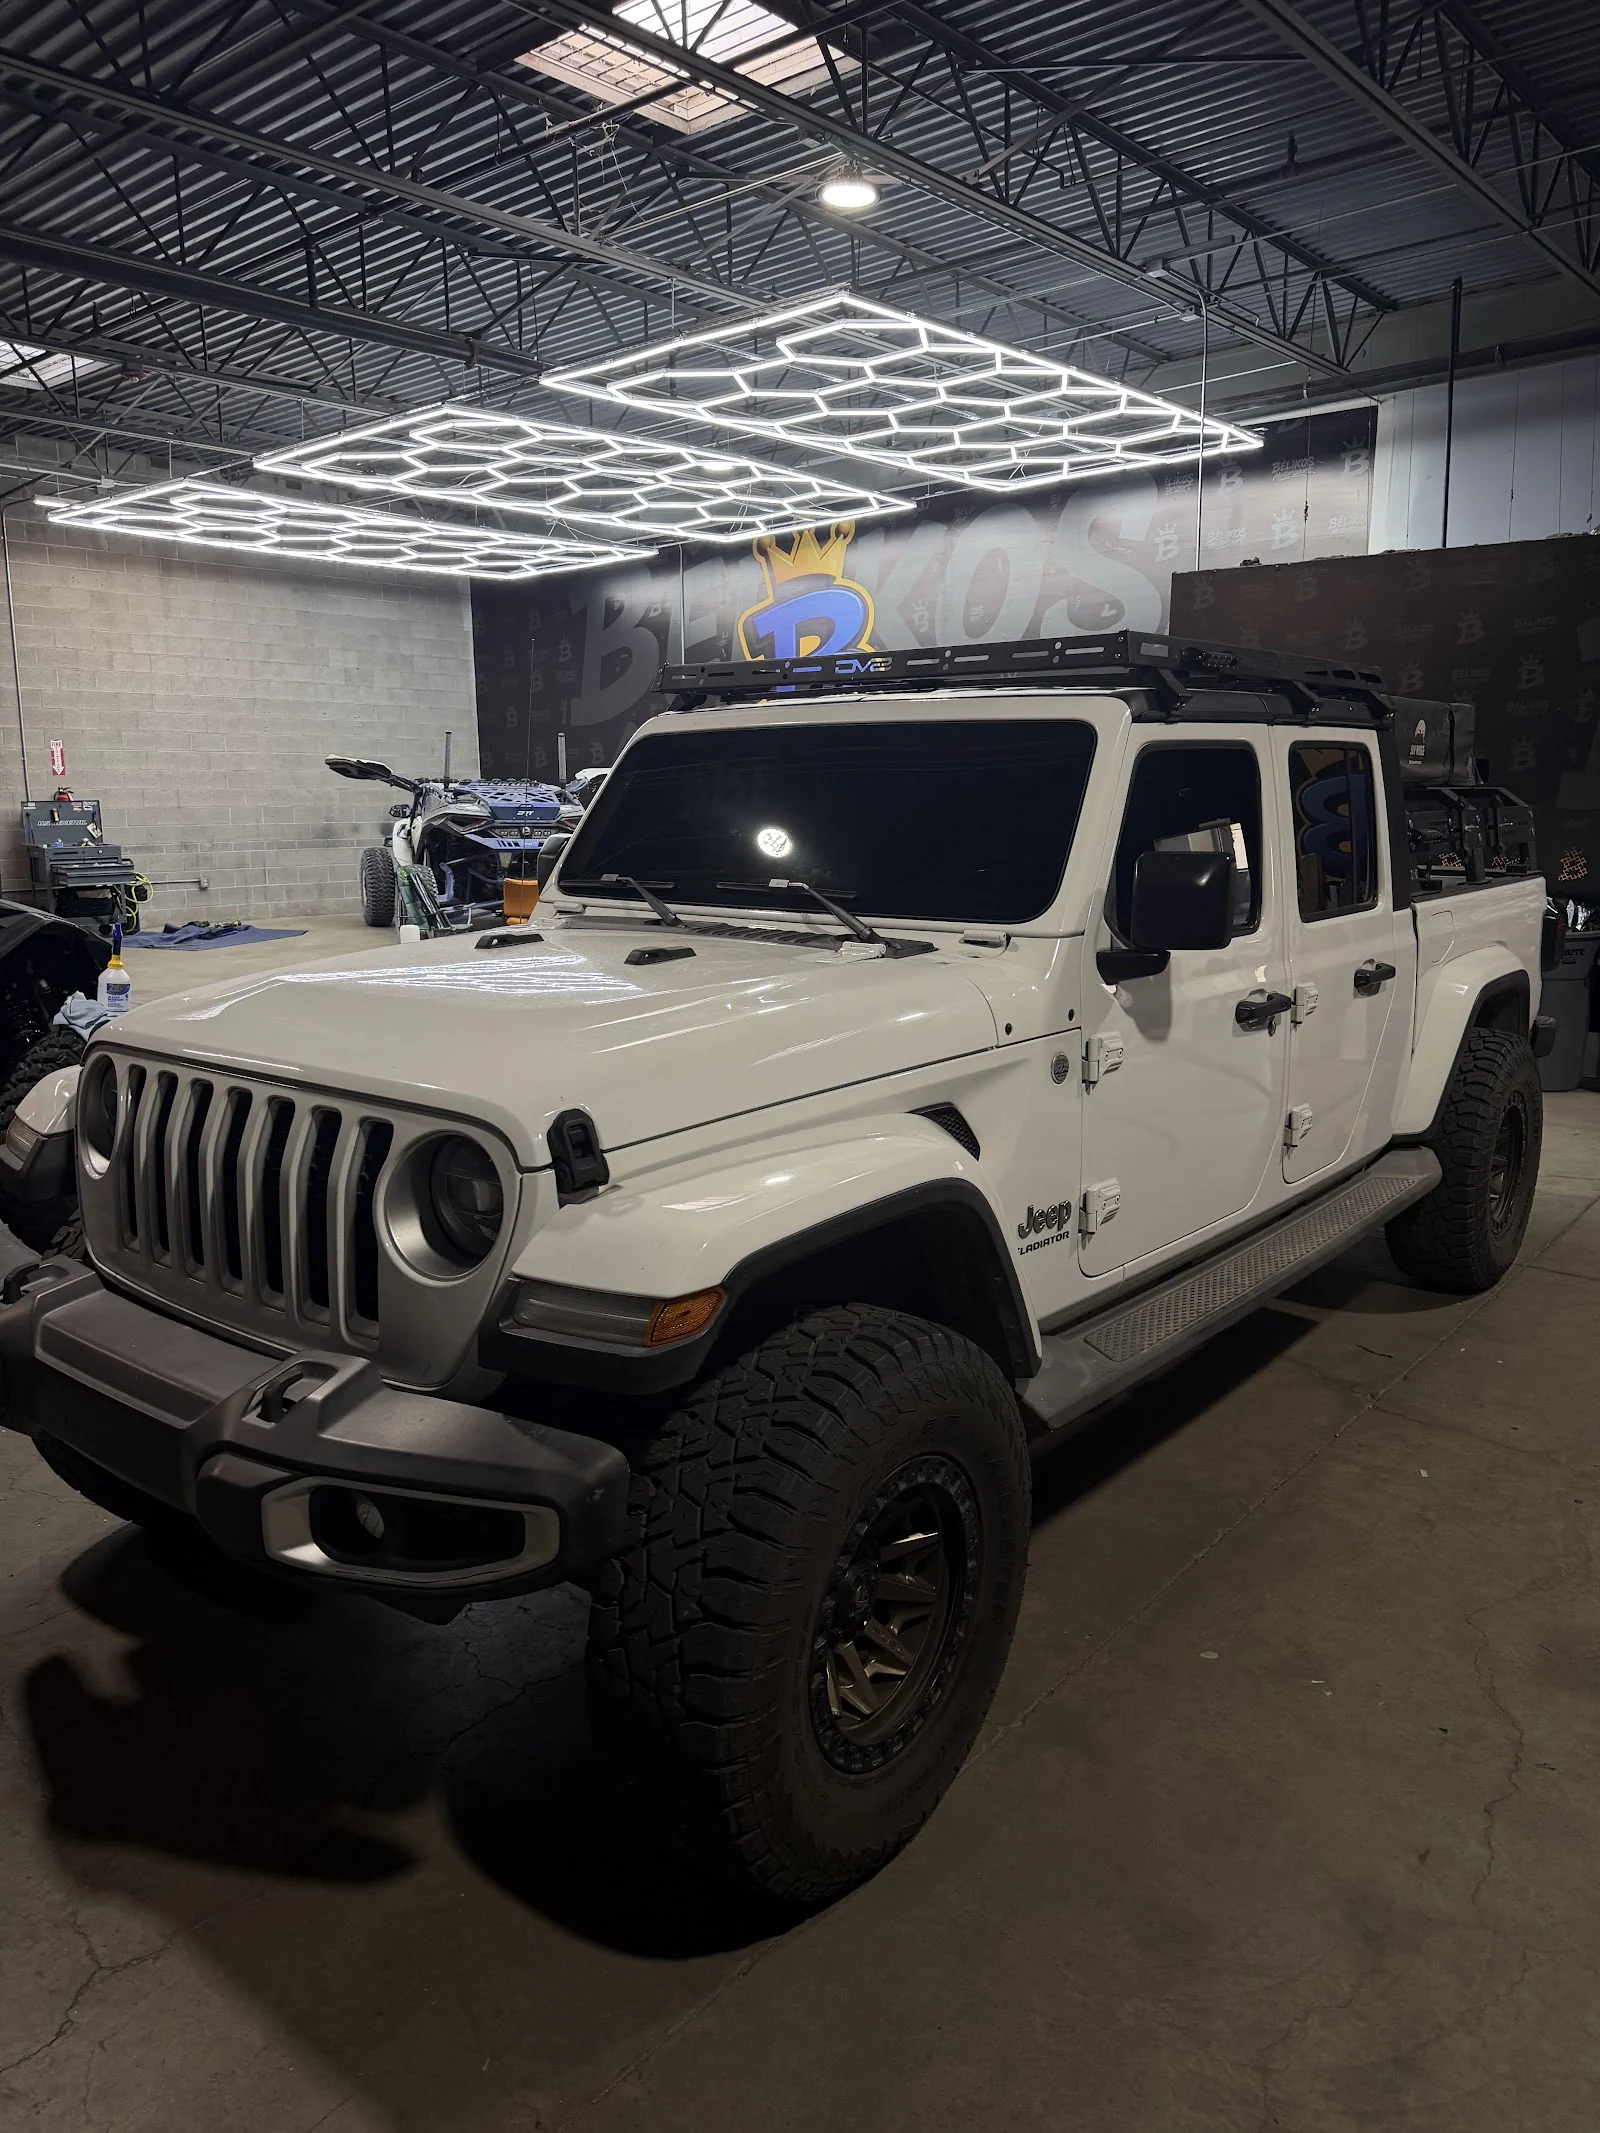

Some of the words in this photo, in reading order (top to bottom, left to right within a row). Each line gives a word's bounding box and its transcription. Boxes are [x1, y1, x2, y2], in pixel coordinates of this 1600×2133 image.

[1154, 533, 1181, 562] B
[1271, 520, 1300, 551] B
[1456, 618, 1485, 645] B
[1018, 1200, 1072, 1240] Jeep
[1017, 1230, 1070, 1256] LADIATOR
